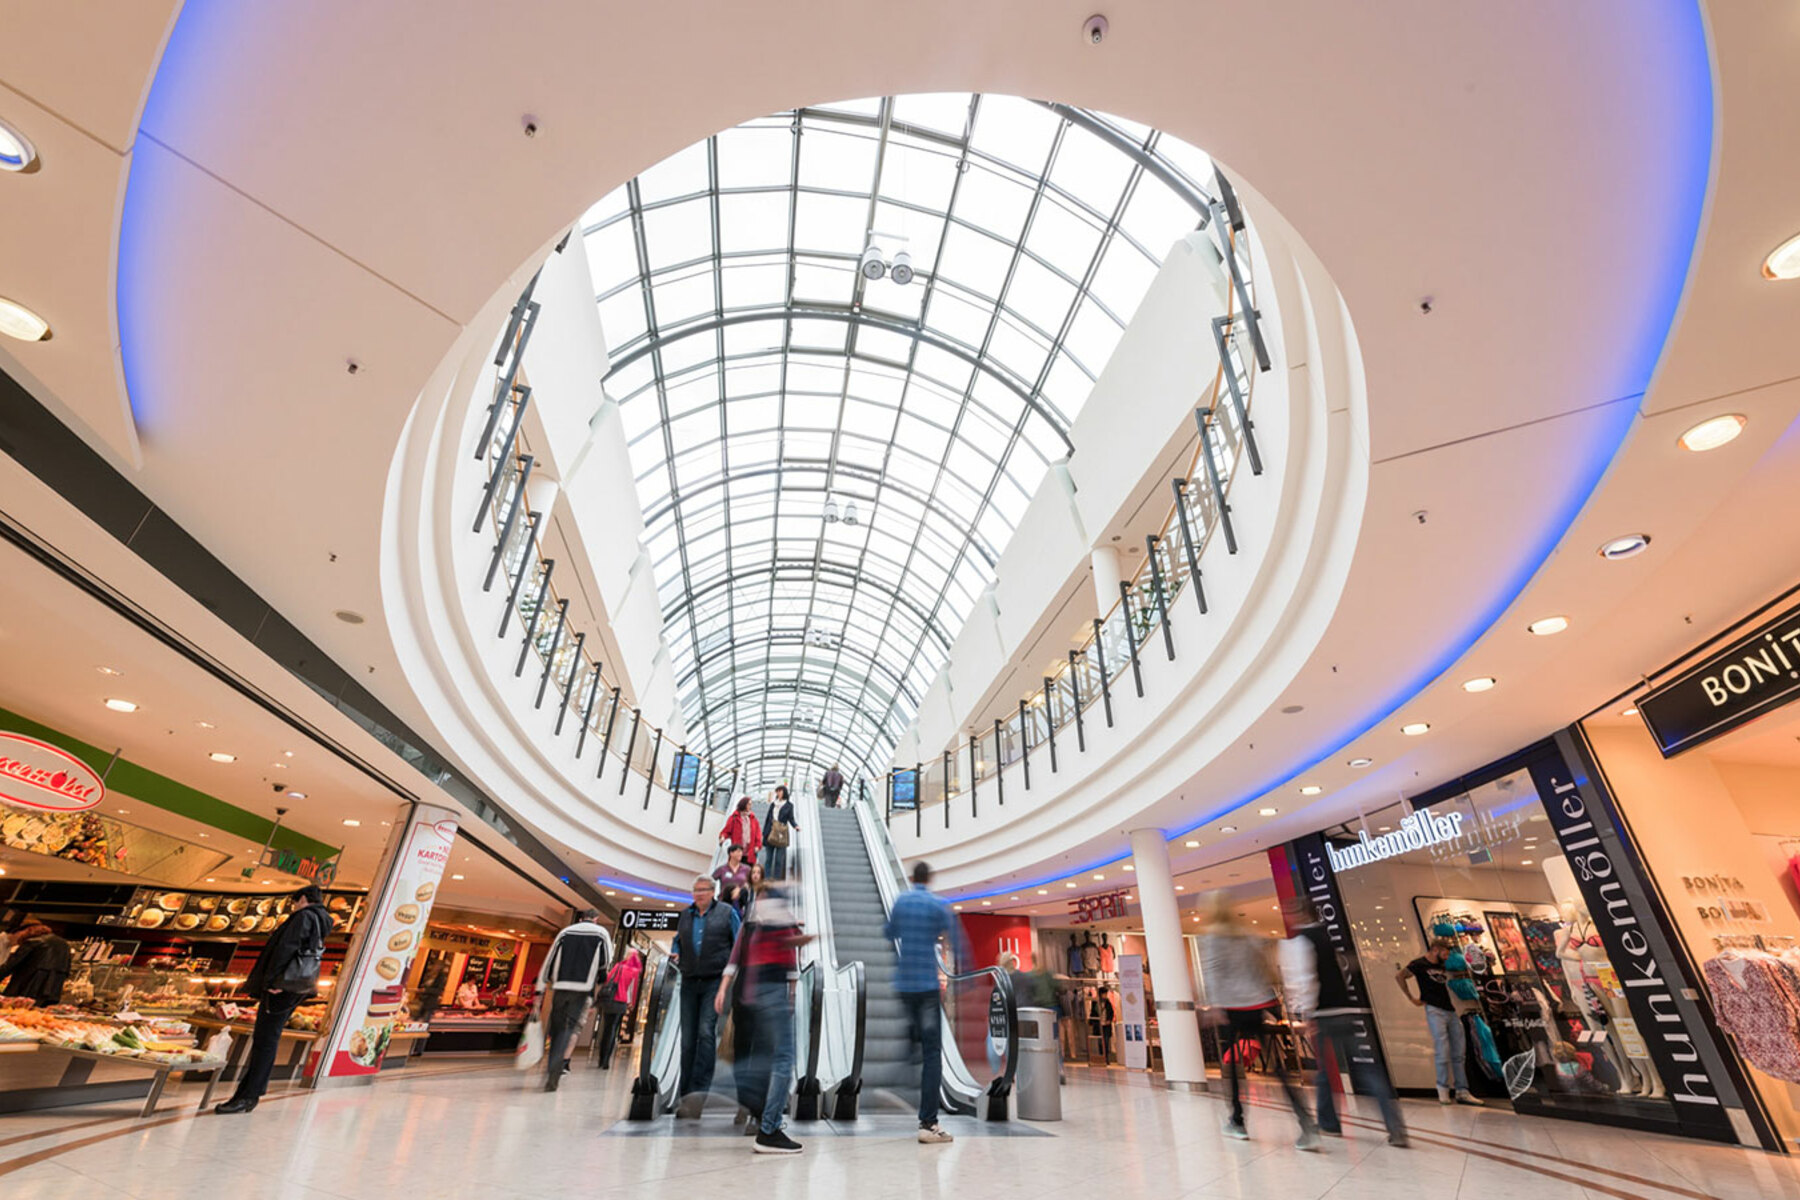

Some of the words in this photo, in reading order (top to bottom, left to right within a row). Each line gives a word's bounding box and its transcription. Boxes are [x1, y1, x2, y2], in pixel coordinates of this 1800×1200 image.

[1325, 808, 1463, 873] hunkemöller
[1068, 890, 1129, 925] ESPRIT
[1550, 777, 1719, 1105] hunkemöller
